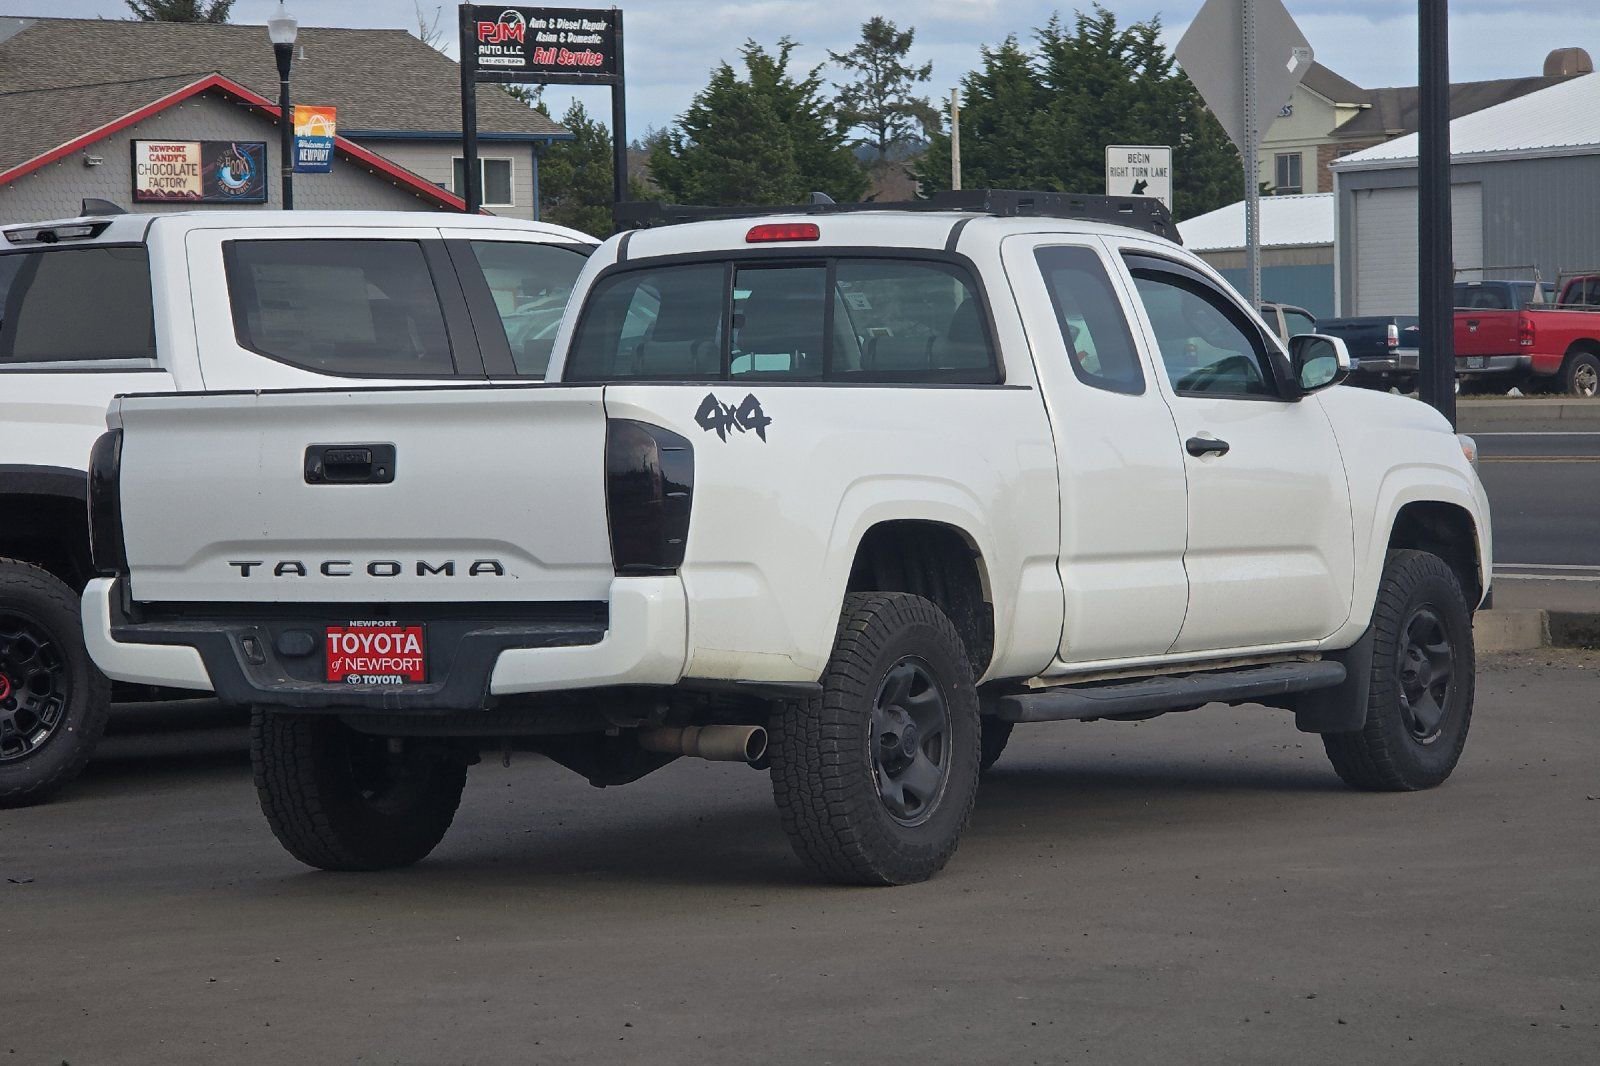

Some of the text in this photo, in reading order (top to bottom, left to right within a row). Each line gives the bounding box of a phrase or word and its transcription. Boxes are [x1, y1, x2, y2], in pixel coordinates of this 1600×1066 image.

[528, 17, 608, 32] Auto & Diesel Repair
[477, 21, 524, 44] PJM
[535, 31, 602, 44] Asian & Domestic
[478, 45, 525, 55] AUTO LLC
[533, 47, 603, 66] Full Service
[149, 153, 187, 163] CANDY'S
[299, 149, 329, 161] NEWPORT
[1127, 153, 1150, 164] BEGIN
[138, 163, 198, 176] CHOCOLATE
[1109, 166, 1168, 178] RIGHT TURN LANE
[149, 177, 187, 188] FACTORY
[227, 559, 506, 578] TACOMA
[327, 633, 422, 654] TOYOTA
[331, 657, 423, 673] of NEWPORT
[362, 675, 403, 685] TOYOTA
